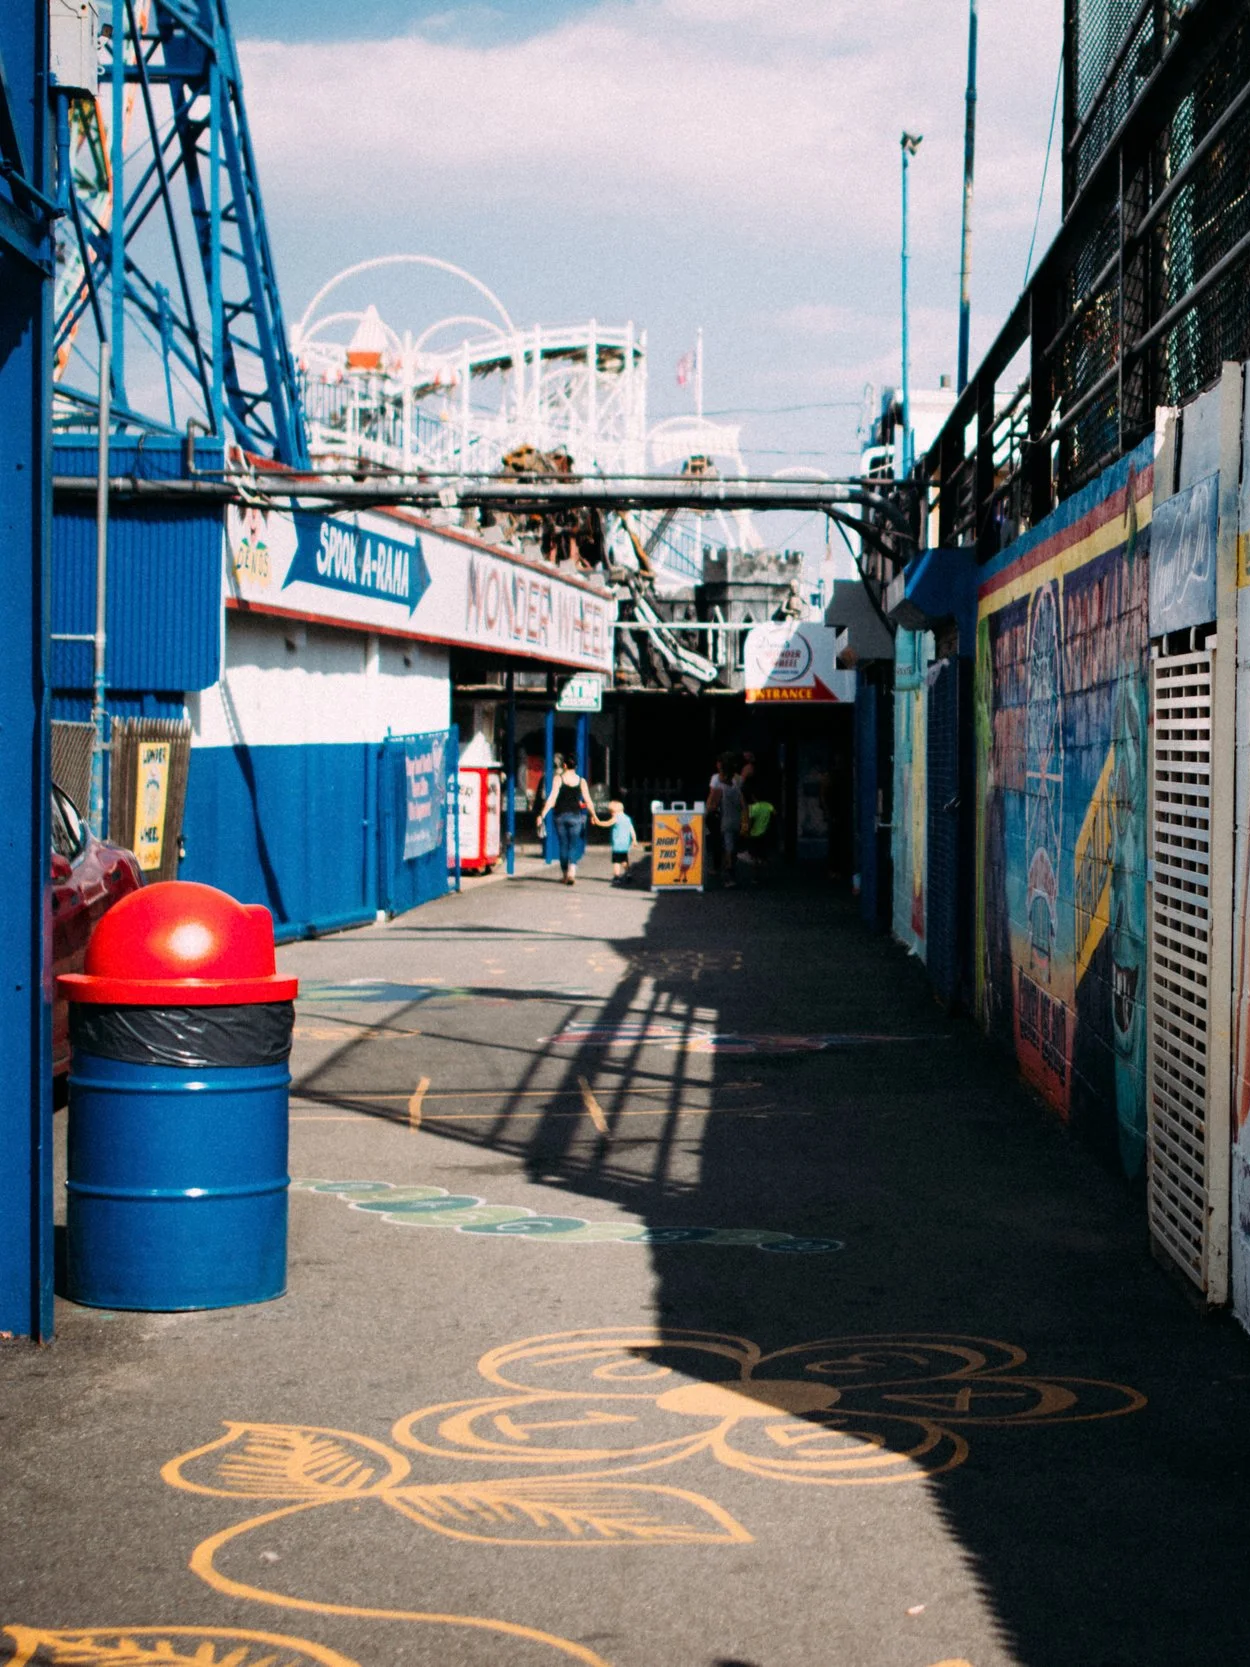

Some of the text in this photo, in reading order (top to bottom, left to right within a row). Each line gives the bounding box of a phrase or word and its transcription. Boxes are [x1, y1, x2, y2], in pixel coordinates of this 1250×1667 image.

[466, 553, 611, 662] WONDER WHEEL
[751, 687, 813, 699] NTRANCE
[656, 837, 679, 846] RIGHT
[660, 850, 677, 858] THIS
[657, 862, 676, 871] WAY
